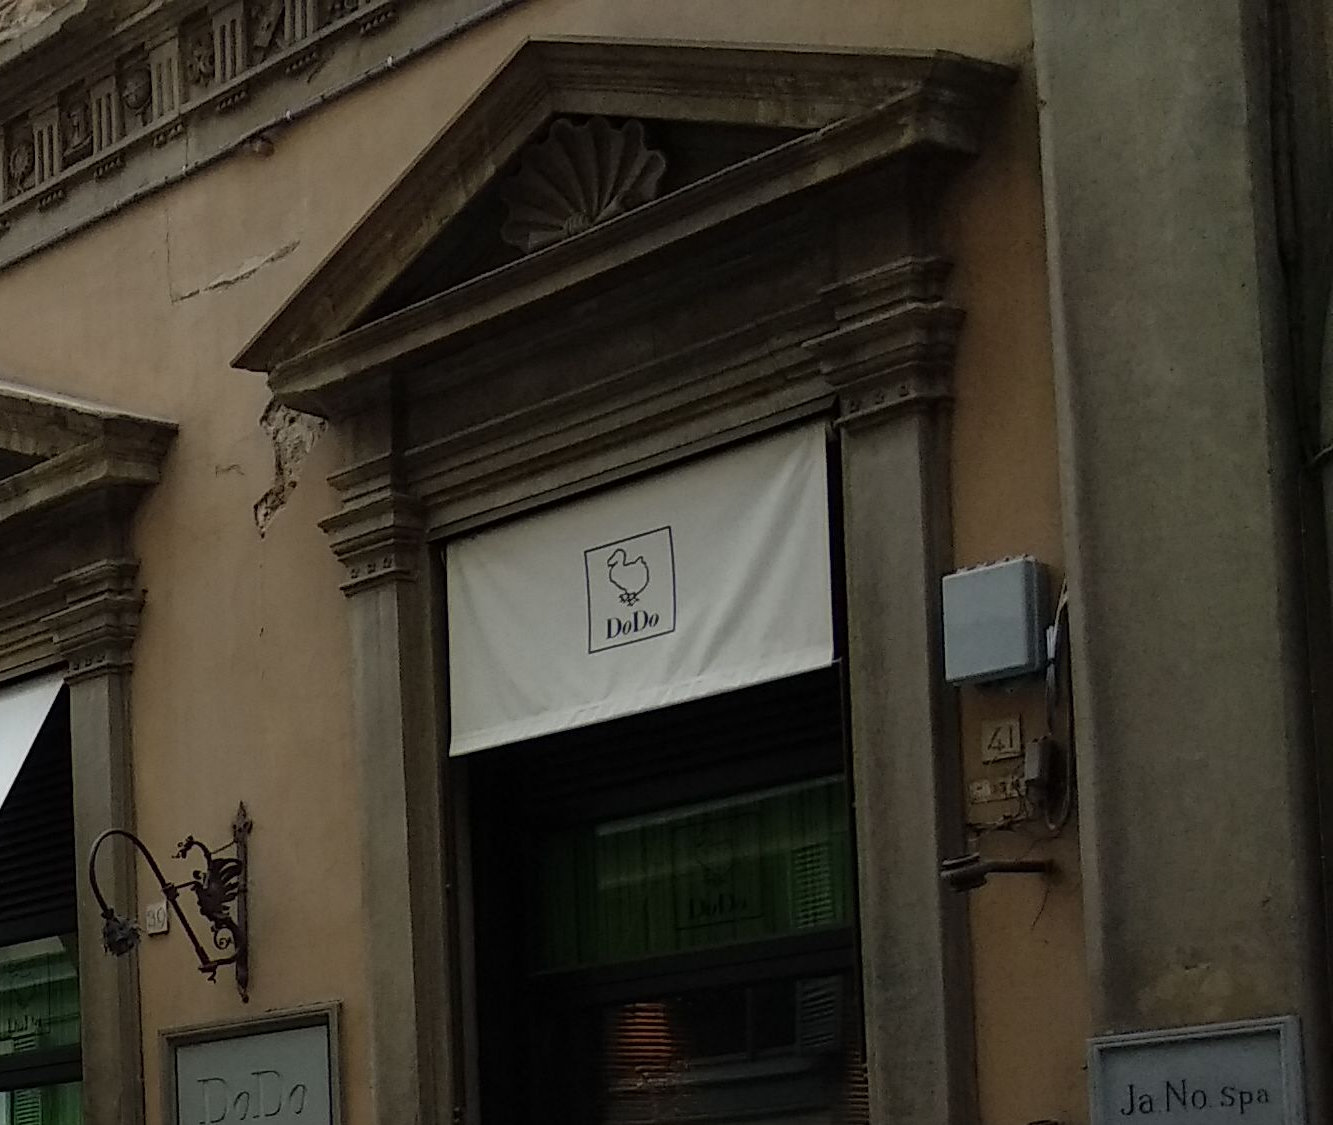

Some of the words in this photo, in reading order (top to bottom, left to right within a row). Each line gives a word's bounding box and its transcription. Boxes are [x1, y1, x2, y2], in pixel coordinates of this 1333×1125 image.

[606, 609, 659, 640] DoDo
[987, 725, 1014, 751] 41
[147, 906, 167, 934] 39
[196, 1069, 309, 1125] DoDo
[1219, 1085, 1270, 1115] Spa
